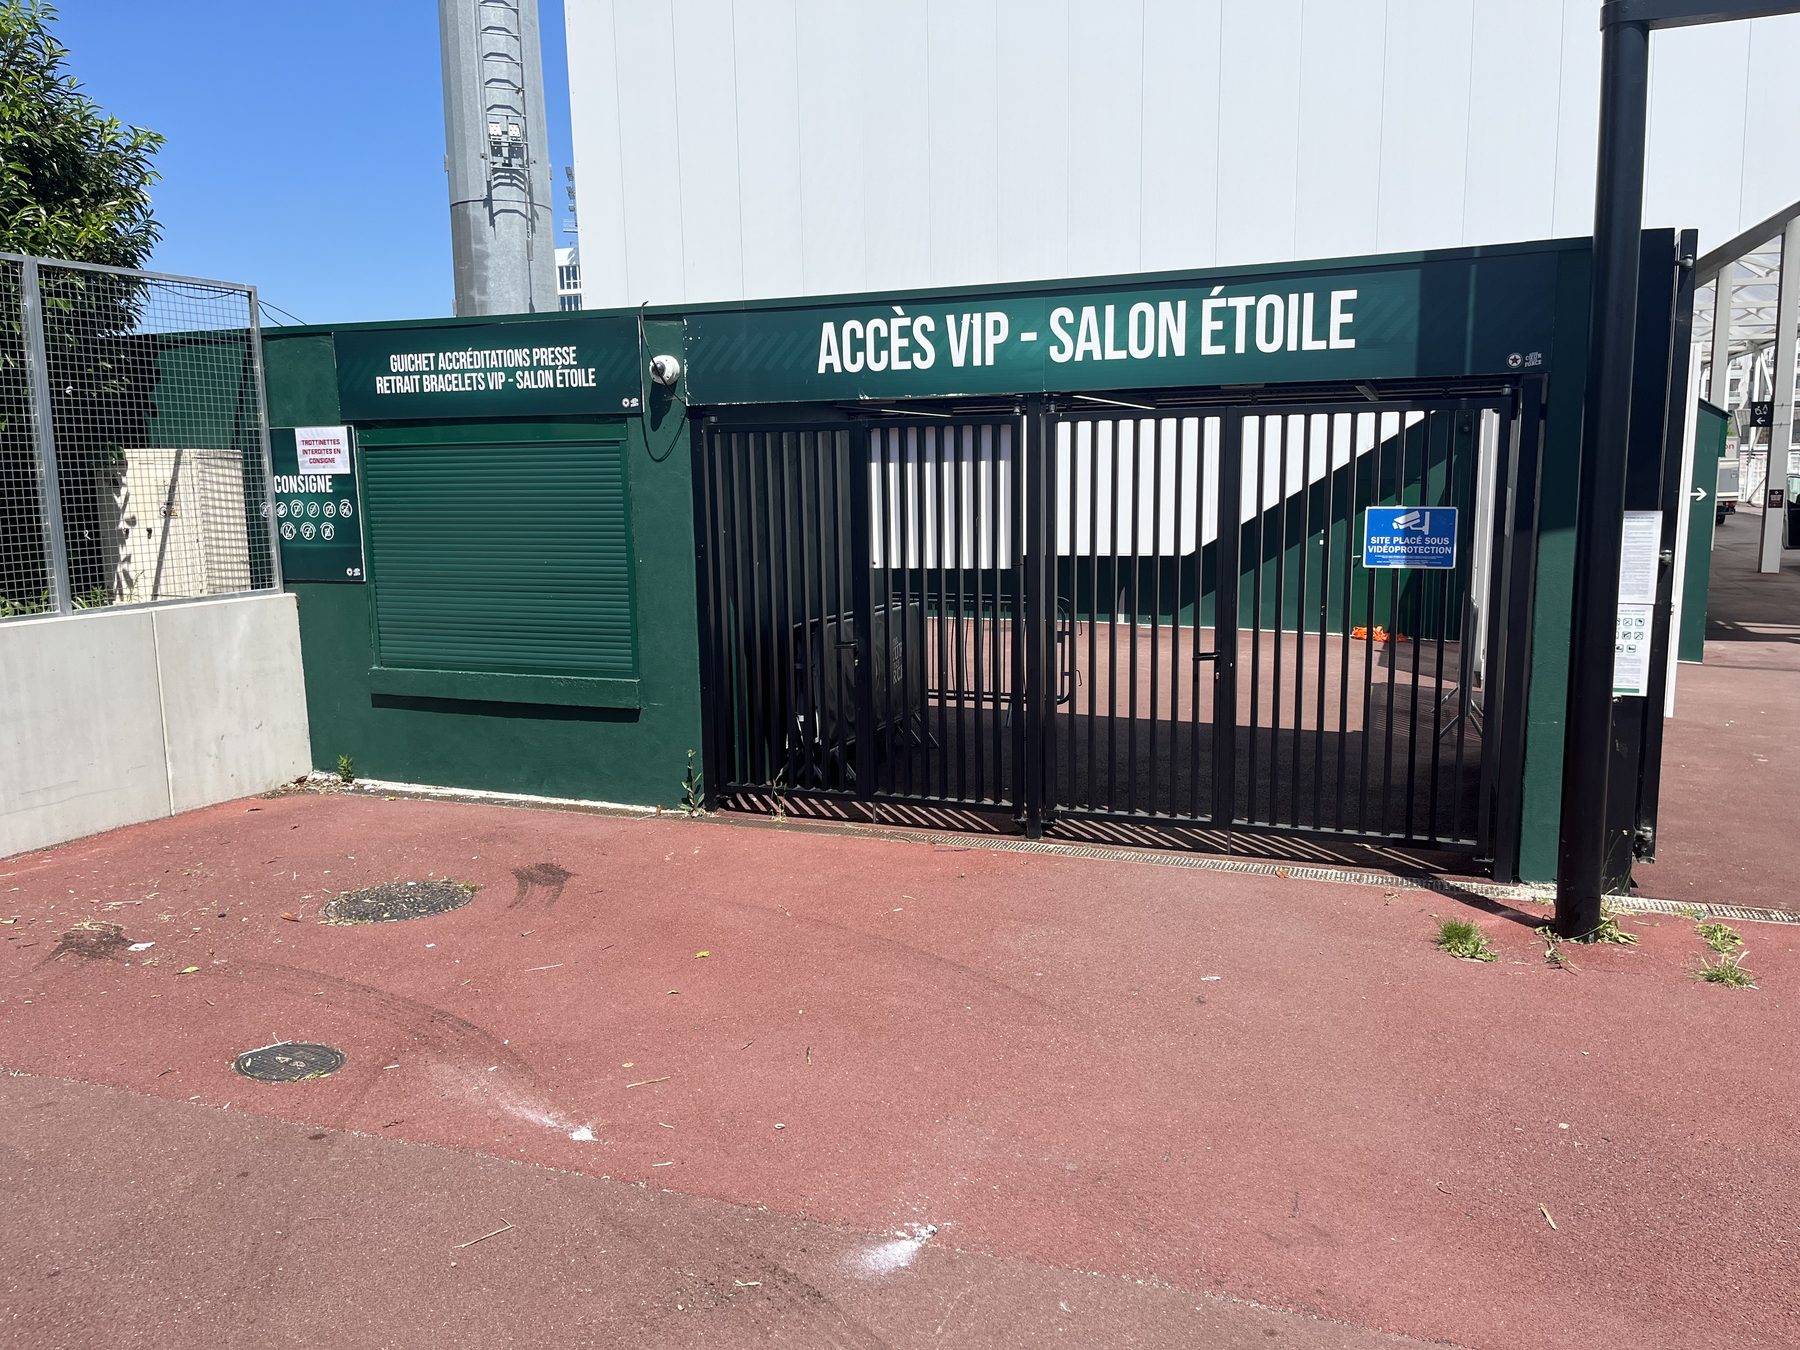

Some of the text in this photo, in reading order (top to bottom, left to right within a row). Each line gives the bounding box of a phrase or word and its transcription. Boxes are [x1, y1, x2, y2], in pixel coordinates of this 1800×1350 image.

[817, 285, 1358, 374] ACCÈS VIP - SALON ÉTOILE
[390, 346, 577, 372] GUICHET ACCRÉDITATIONS PRESSE
[376, 375, 422, 394] RETRAIT
[423, 371, 486, 393] BRACELETS
[486, 370, 506, 390] VIP
[516, 368, 555, 389] SALON
[556, 366, 596, 387] ÉTOILE
[274, 475, 333, 493] CONSIGNE
[1368, 544, 1451, 554] VIDÉOPROTECTION
[1393, 535, 1422, 544] PLACÉ
[1424, 537, 1449, 545] SOUS
